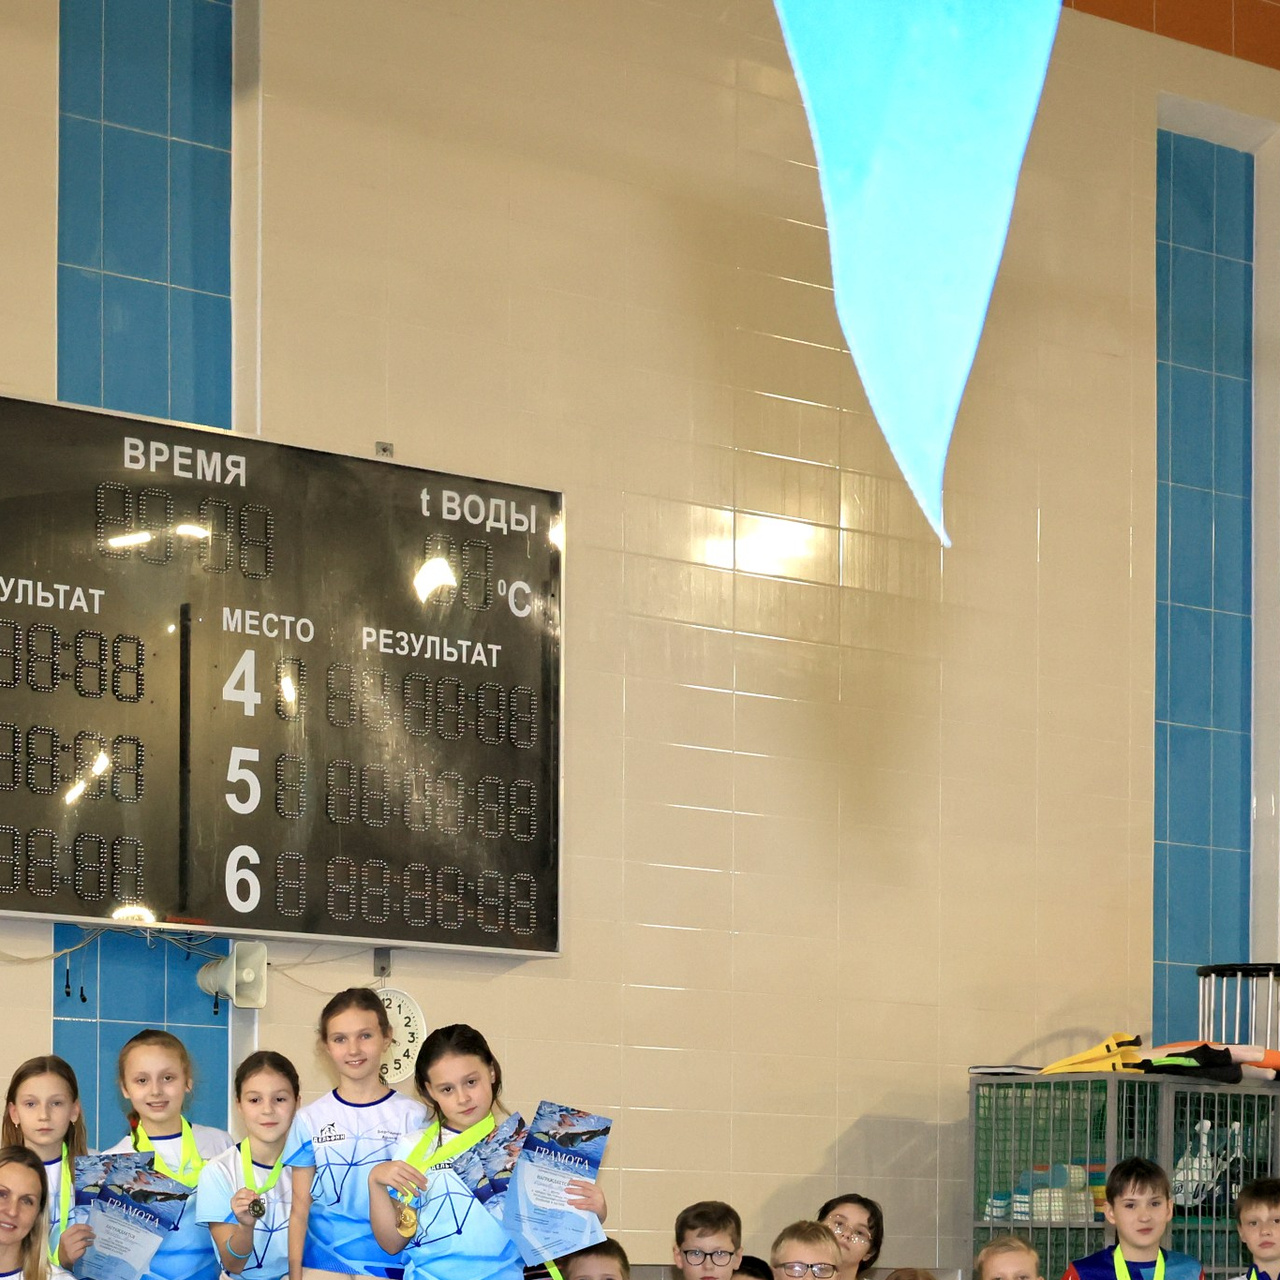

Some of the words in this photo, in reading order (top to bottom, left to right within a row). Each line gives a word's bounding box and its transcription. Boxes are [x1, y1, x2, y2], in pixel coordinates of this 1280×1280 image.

[124, 437, 247, 487] ВРЕМЯ
[420, 488, 431, 516] t
[442, 490, 536, 535] ВОДЫ
[222, 607, 315, 643] МЕСТО
[362, 627, 502, 667] РЕЗУЛЬТАТ
[222, 650, 261, 716] 4
[225, 746, 261, 815] 5
[225, 845, 261, 913] 6
[397, 1004, 402, 1015] 1
[404, 1016, 411, 1027] 2
[408, 1032, 415, 1043] 3
[394, 1059, 401, 1070] 5
[403, 1048, 410, 1059] 4
[380, 1063, 389, 1075] 6
[430, 1162, 453, 1171] ДЕЛЬ
[535, 1145, 590, 1171] ГРАМОТА
[107, 1197, 160, 1228] ГРАМОТА
